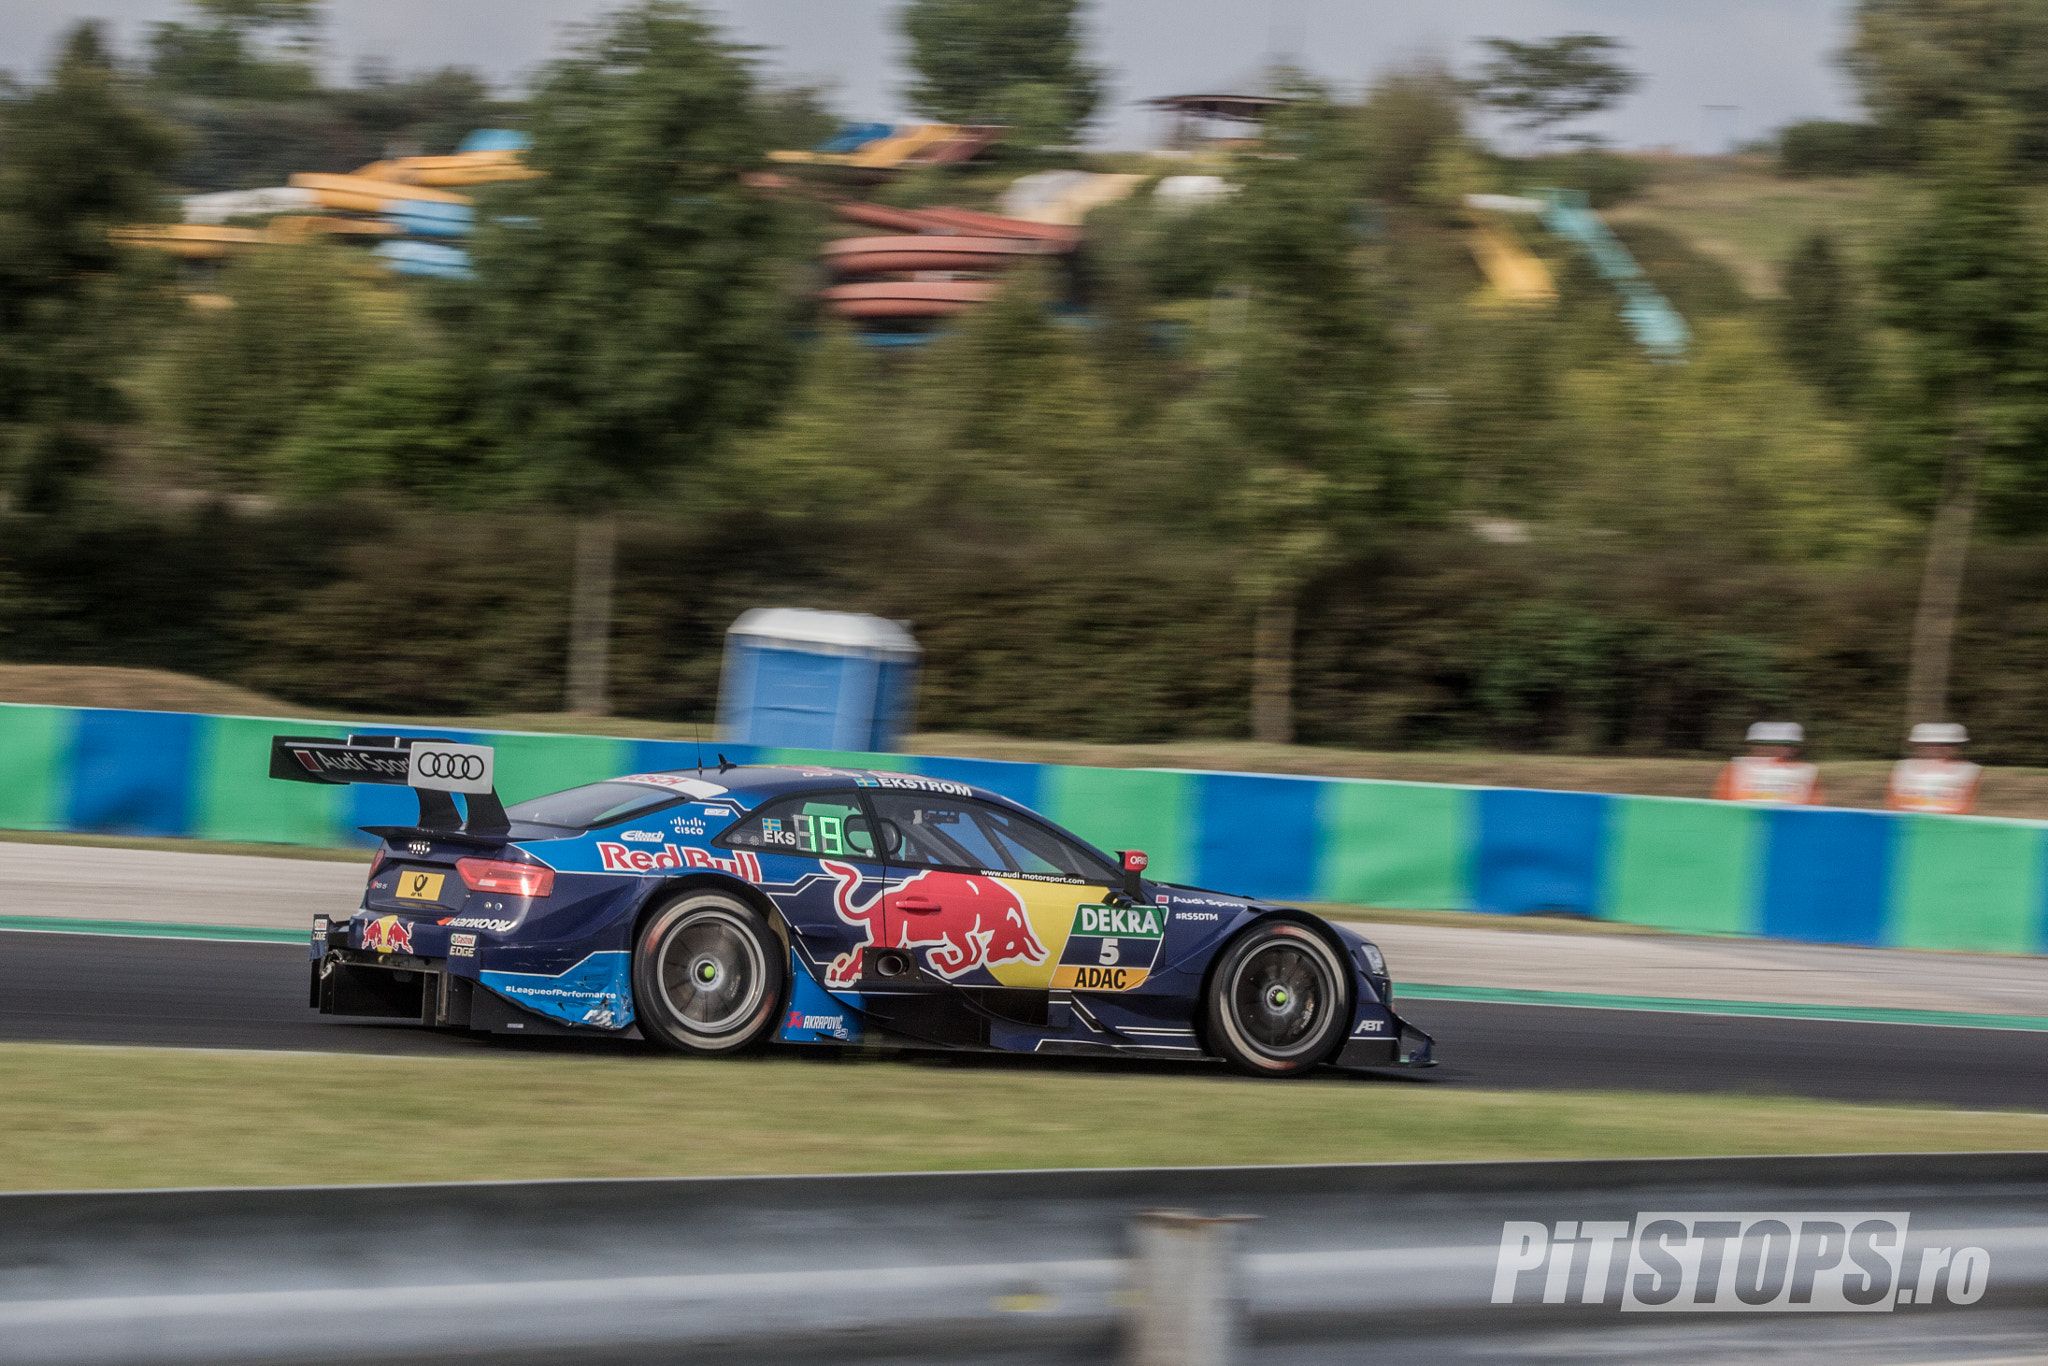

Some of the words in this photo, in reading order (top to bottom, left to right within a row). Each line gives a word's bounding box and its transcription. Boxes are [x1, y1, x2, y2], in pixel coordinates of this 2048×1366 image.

[316, 751, 368, 771] Audi
[877, 778, 973, 797] EKSTROM
[763, 829, 796, 846] EKS
[808, 815, 843, 855] 19
[596, 842, 683, 873] Red
[681, 846, 762, 883] Bull
[1172, 896, 1205, 905] Audi
[1081, 907, 1160, 934] DEKRA
[449, 946, 476, 957] EDGE
[1098, 936, 1120, 966] 5
[1074, 967, 1127, 989] ADAC
[505, 985, 617, 999] #LeagueofPerformance
[1354, 1020, 1384, 1034] ABT
